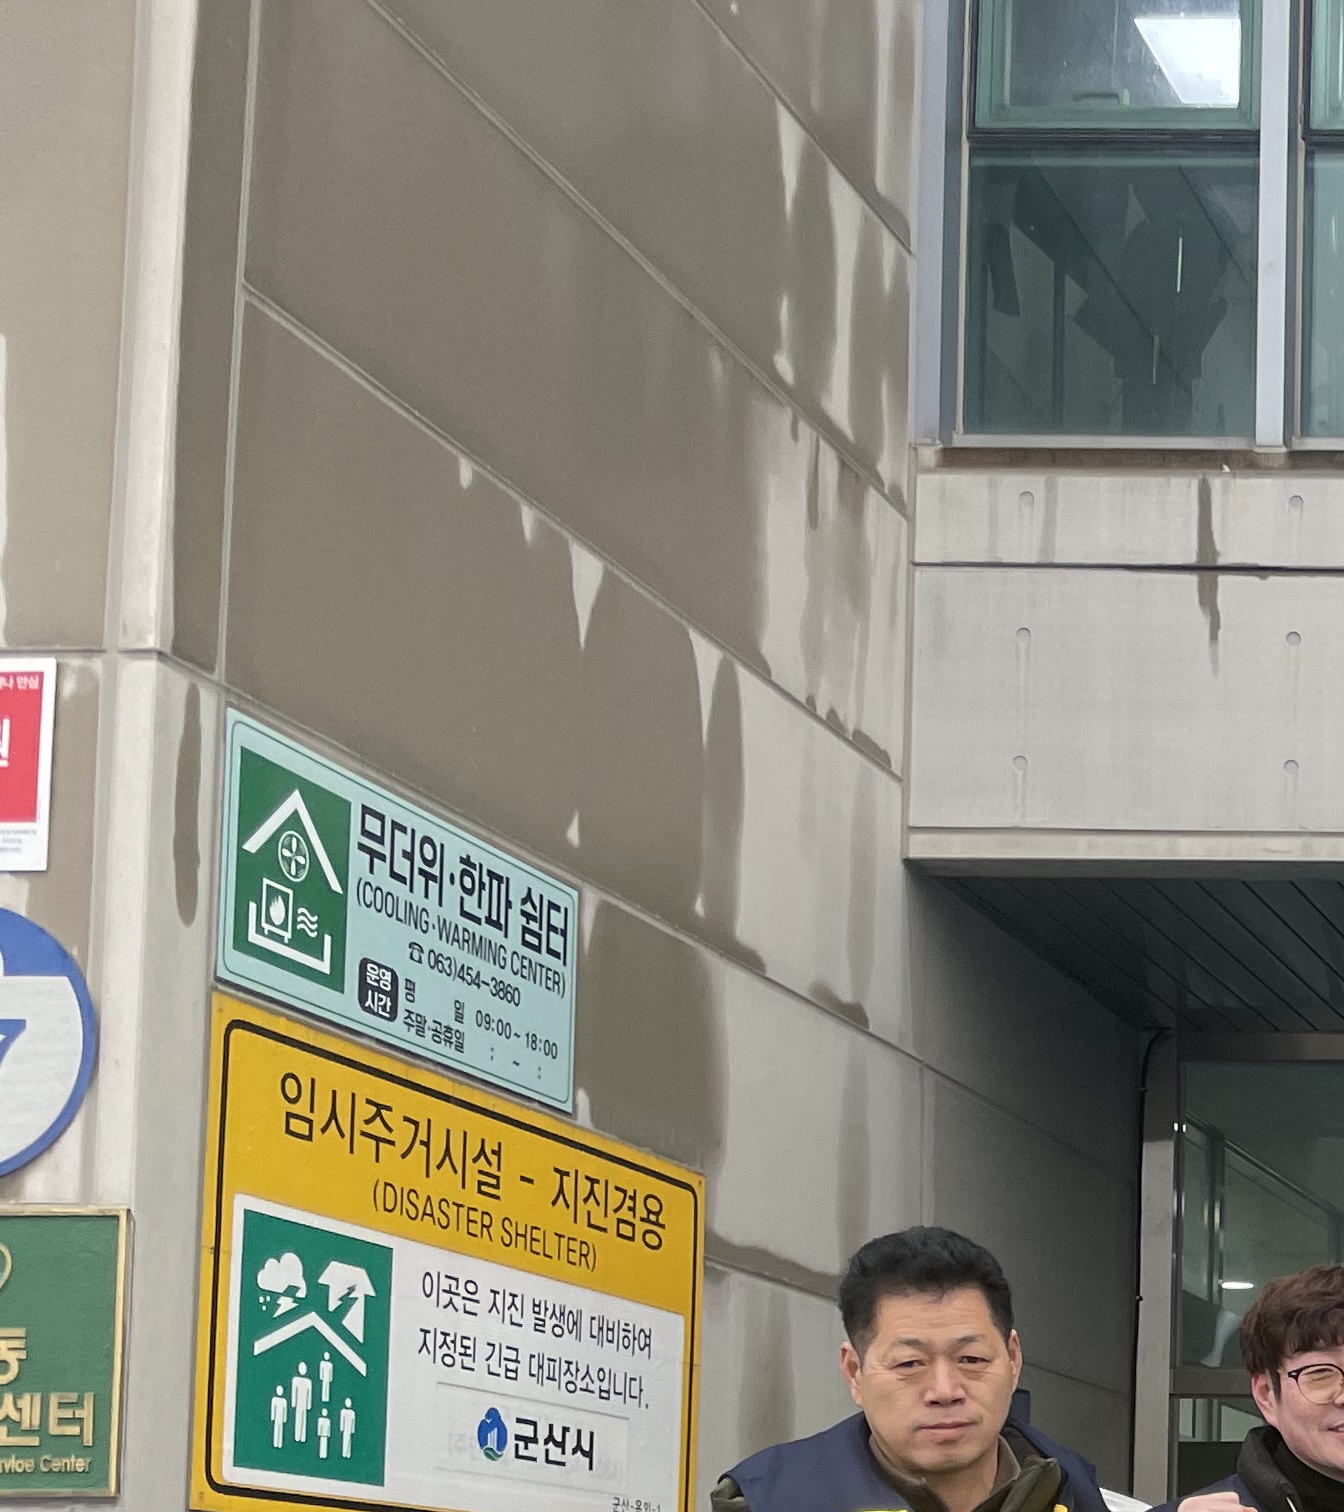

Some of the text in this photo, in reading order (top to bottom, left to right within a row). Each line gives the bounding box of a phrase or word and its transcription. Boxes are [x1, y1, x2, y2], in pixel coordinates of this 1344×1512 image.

[520, 887, 568, 966] 쉼터
[365, 989, 392, 1018] 시간
[366, 963, 392, 991] 운영
[428, 949, 521, 1007] 063)454-3860
[510, 953, 566, 999] CENTER)
[280, 1072, 502, 1201] 임시주거시설
[551, 1166, 666, 1250] 지진겸용
[373, 1178, 597, 1272] (DISASTER SHELTER)
[422, 1271, 652, 1360] 이곳은 지진 발생에 대비하여
[418, 1327, 649, 1409] 지정된 긴급 대피장소입니다.
[39, 1455, 91, 1473] Center
[514, 1417, 594, 1471] 군산시
